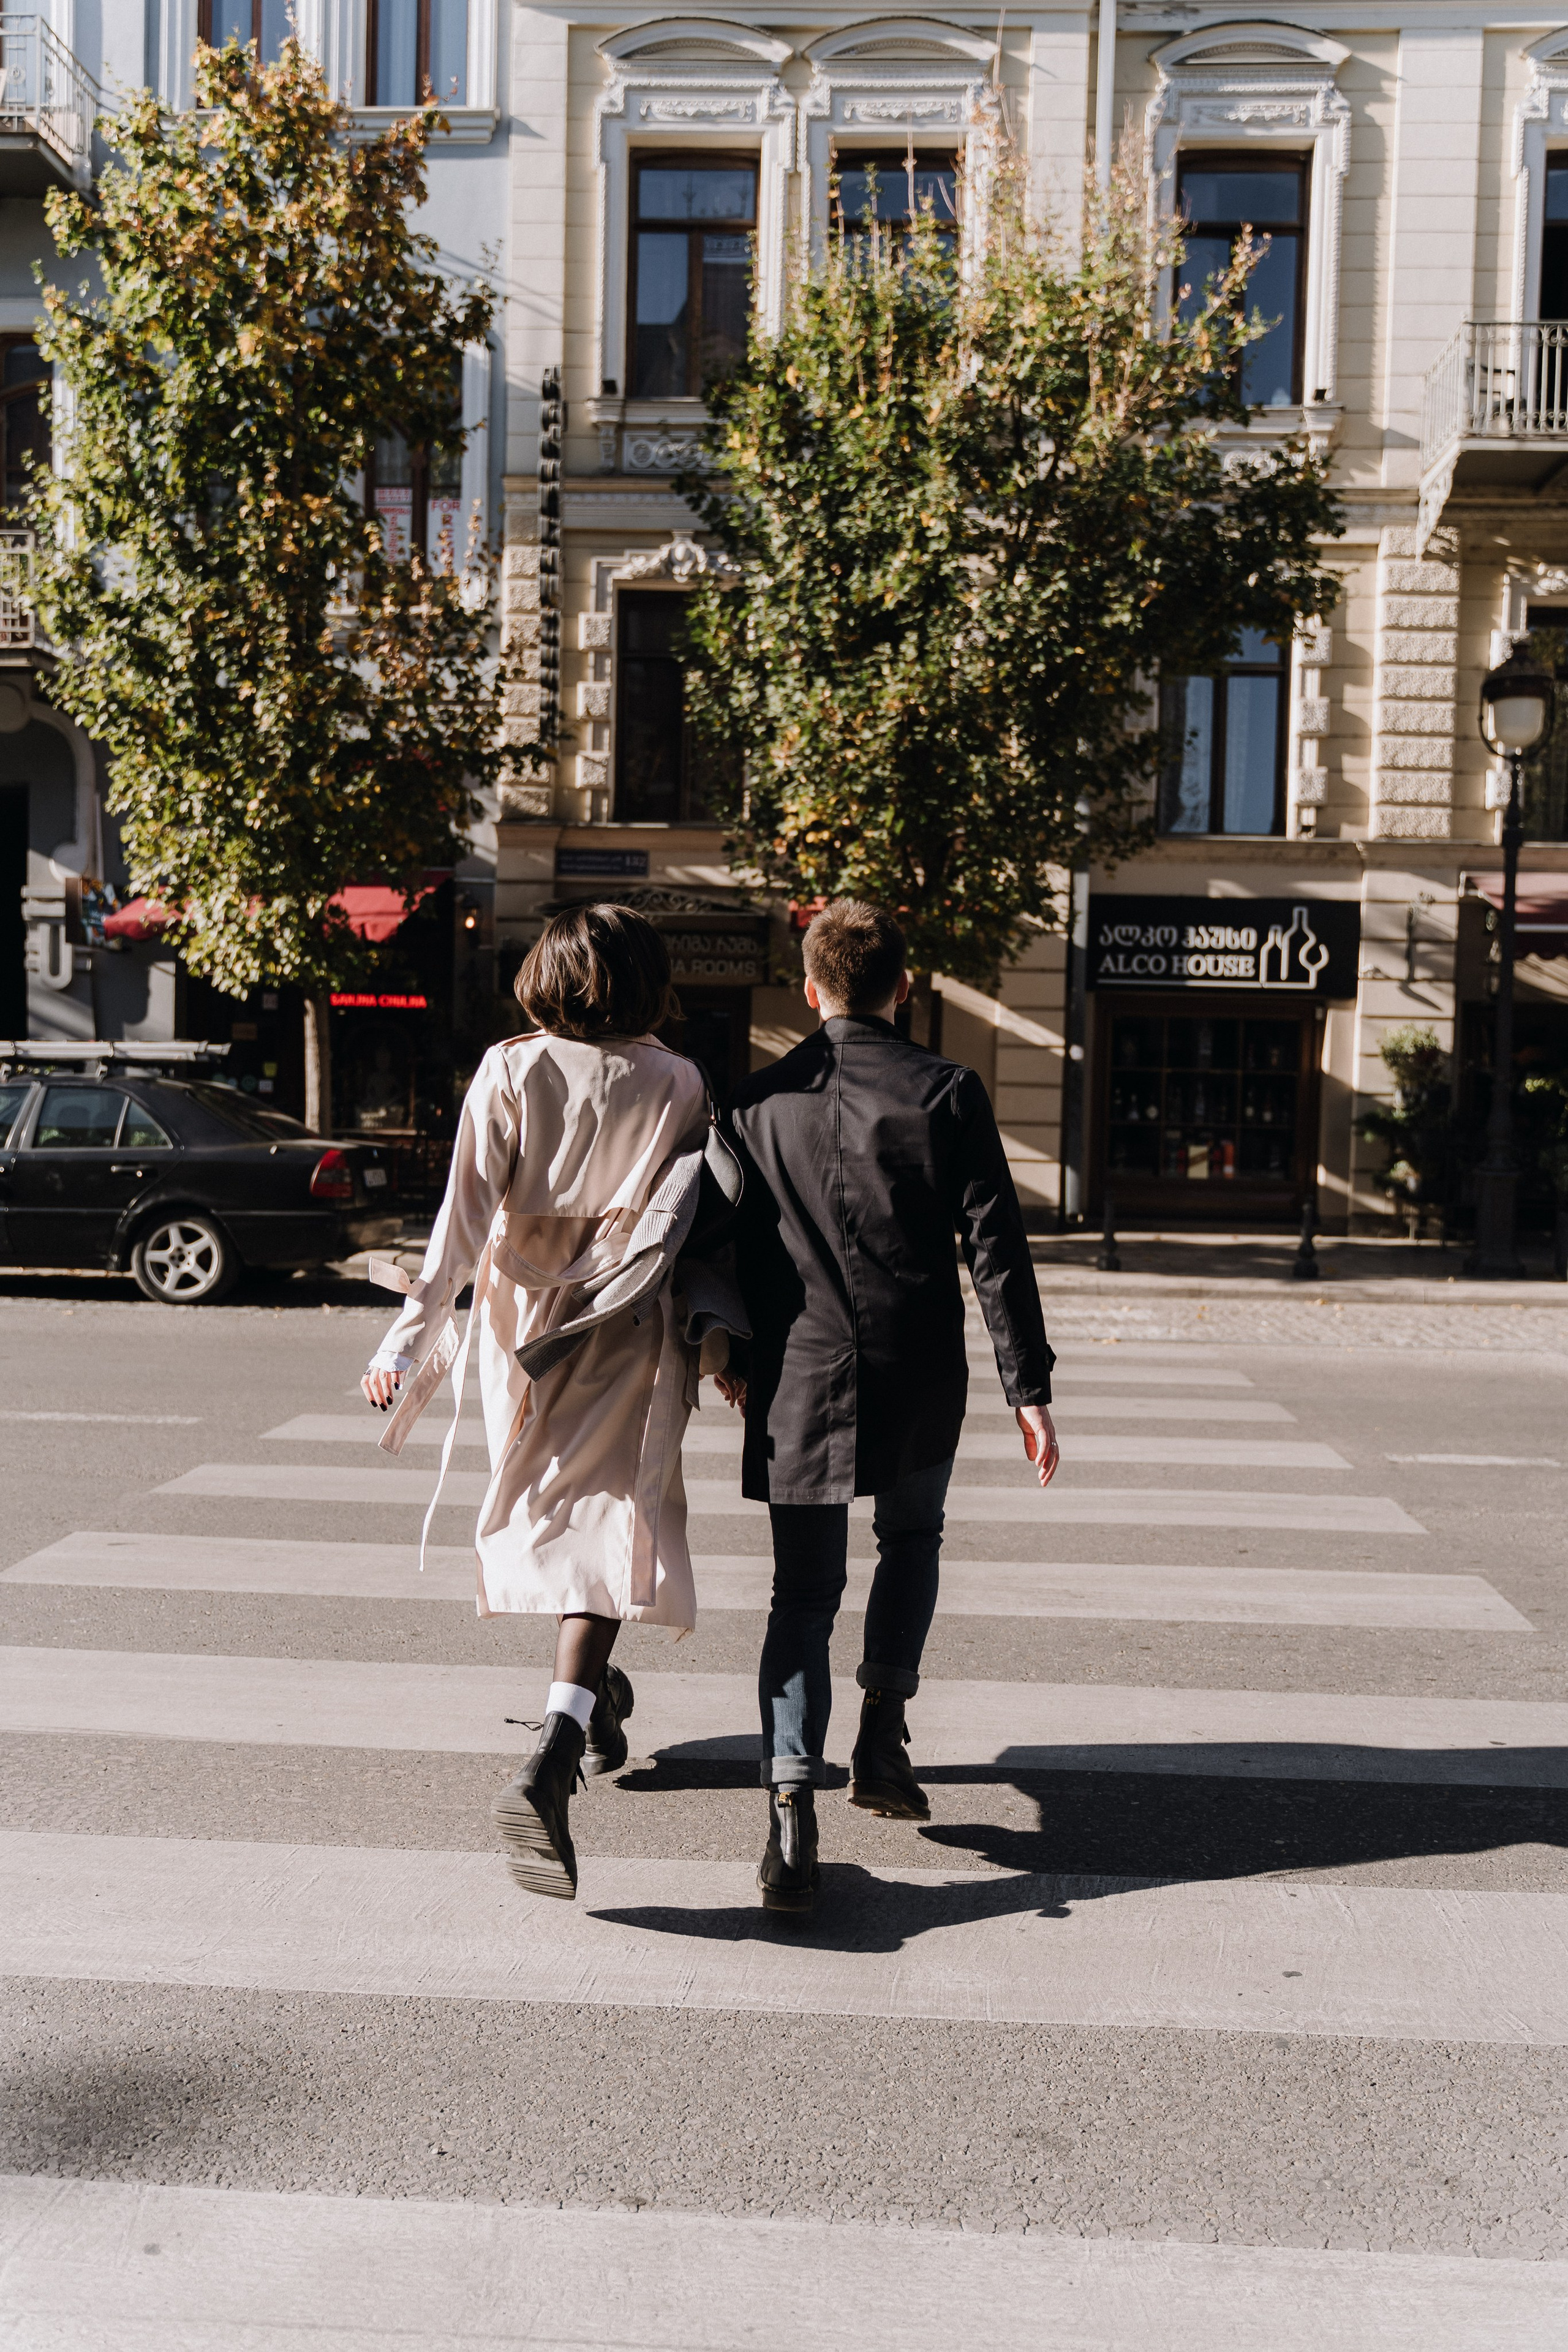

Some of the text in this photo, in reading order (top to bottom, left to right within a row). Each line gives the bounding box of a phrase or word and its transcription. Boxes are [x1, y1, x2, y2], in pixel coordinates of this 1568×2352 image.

[431, 498, 460, 512] FOR
[1099, 924, 1178, 948] ალკო
[692, 959, 756, 977] ROOMS
[1098, 954, 1256, 978] ALCO HOUSE
